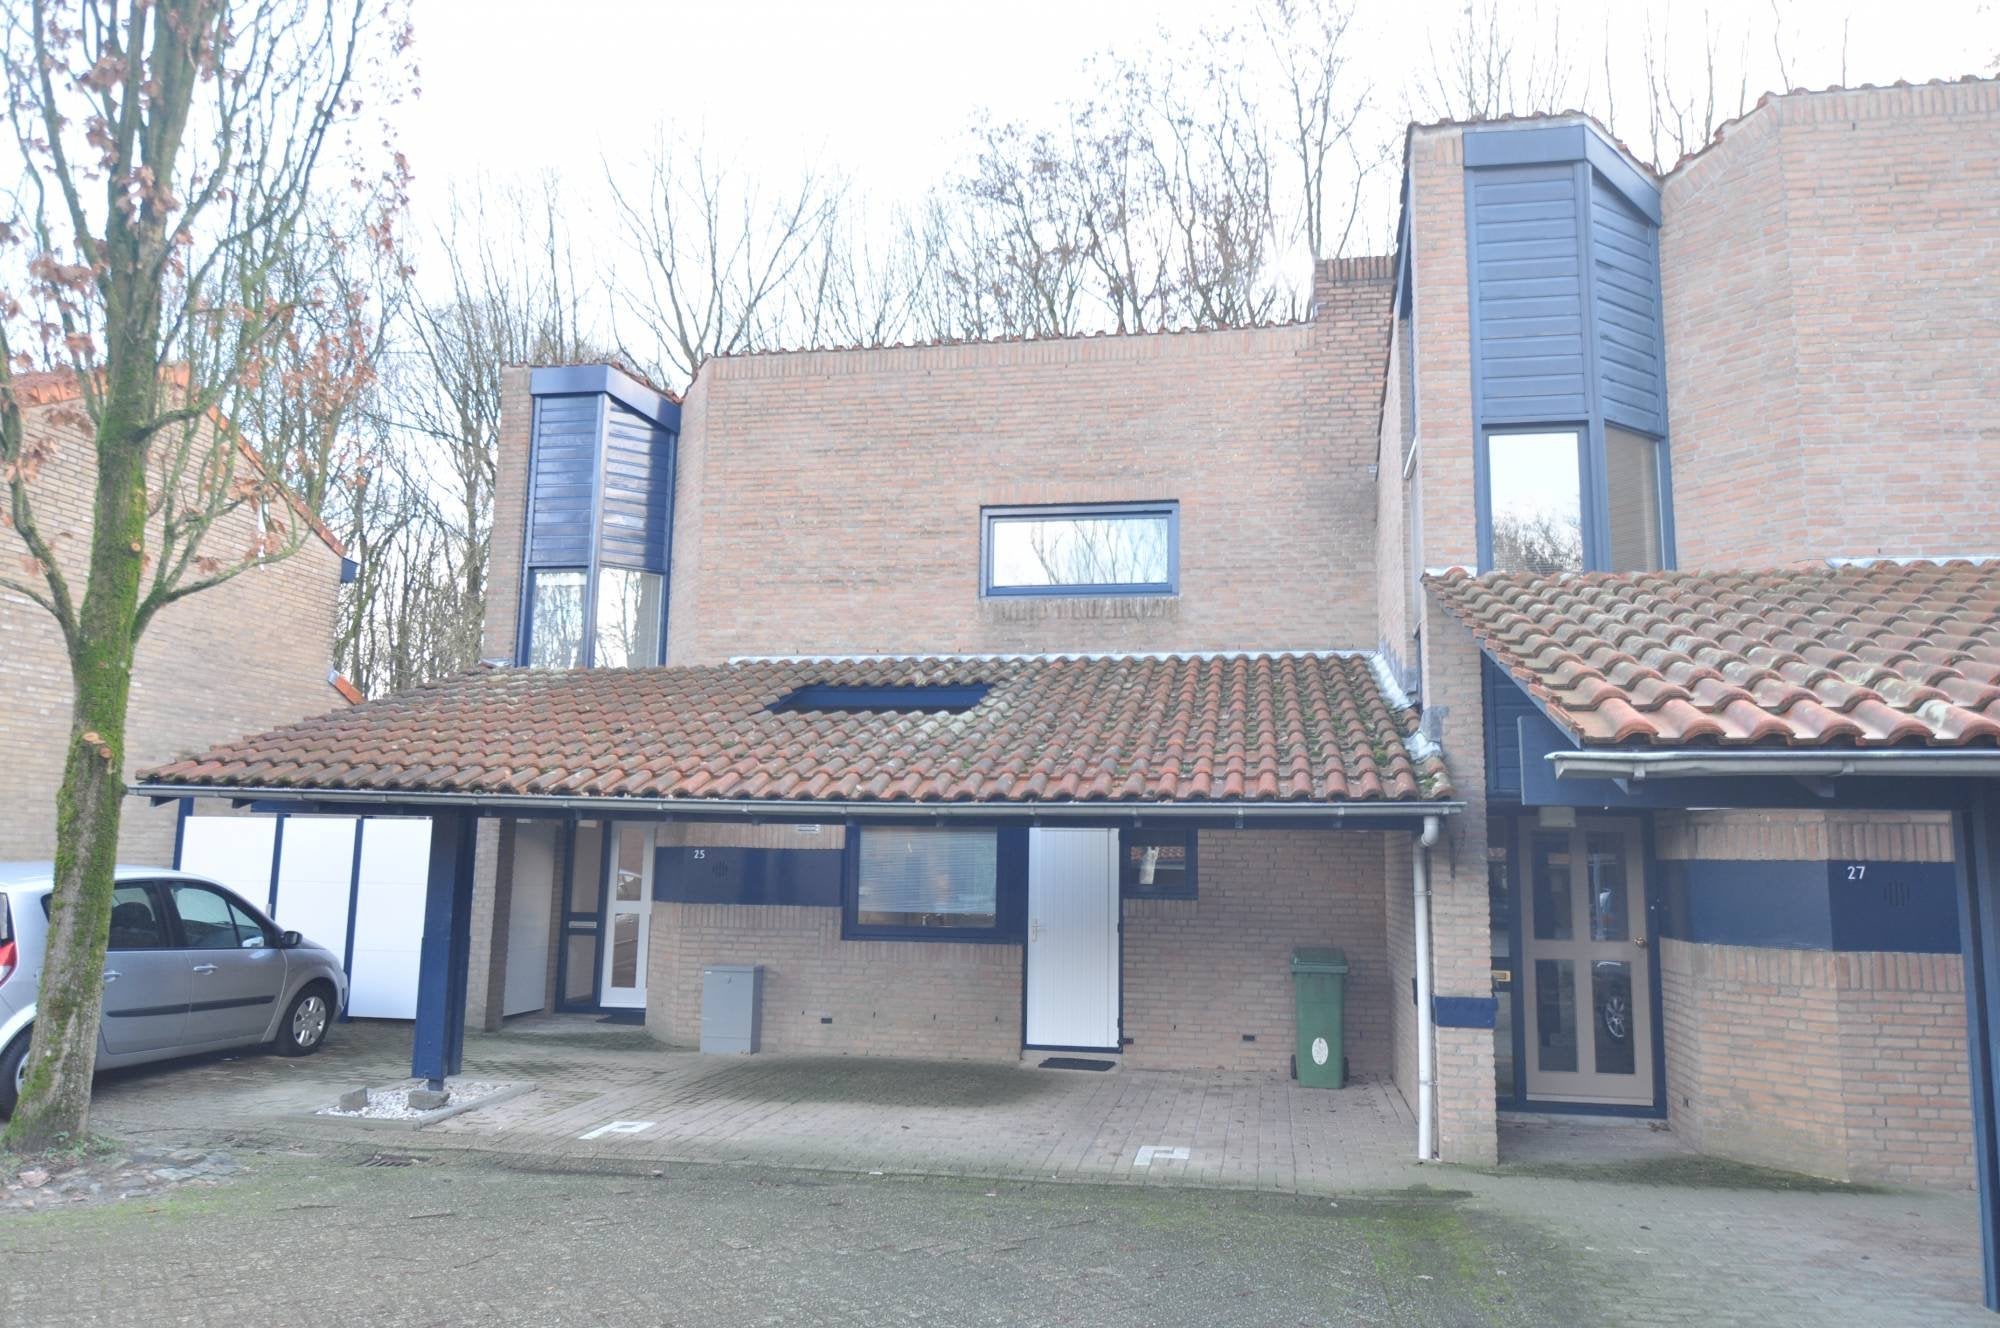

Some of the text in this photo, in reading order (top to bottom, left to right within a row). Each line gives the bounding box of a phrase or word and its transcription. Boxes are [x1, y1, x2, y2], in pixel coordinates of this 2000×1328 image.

[694, 849, 705, 859] 25
[1847, 865, 1866, 880] 27
[577, 1120, 657, 1140] P
